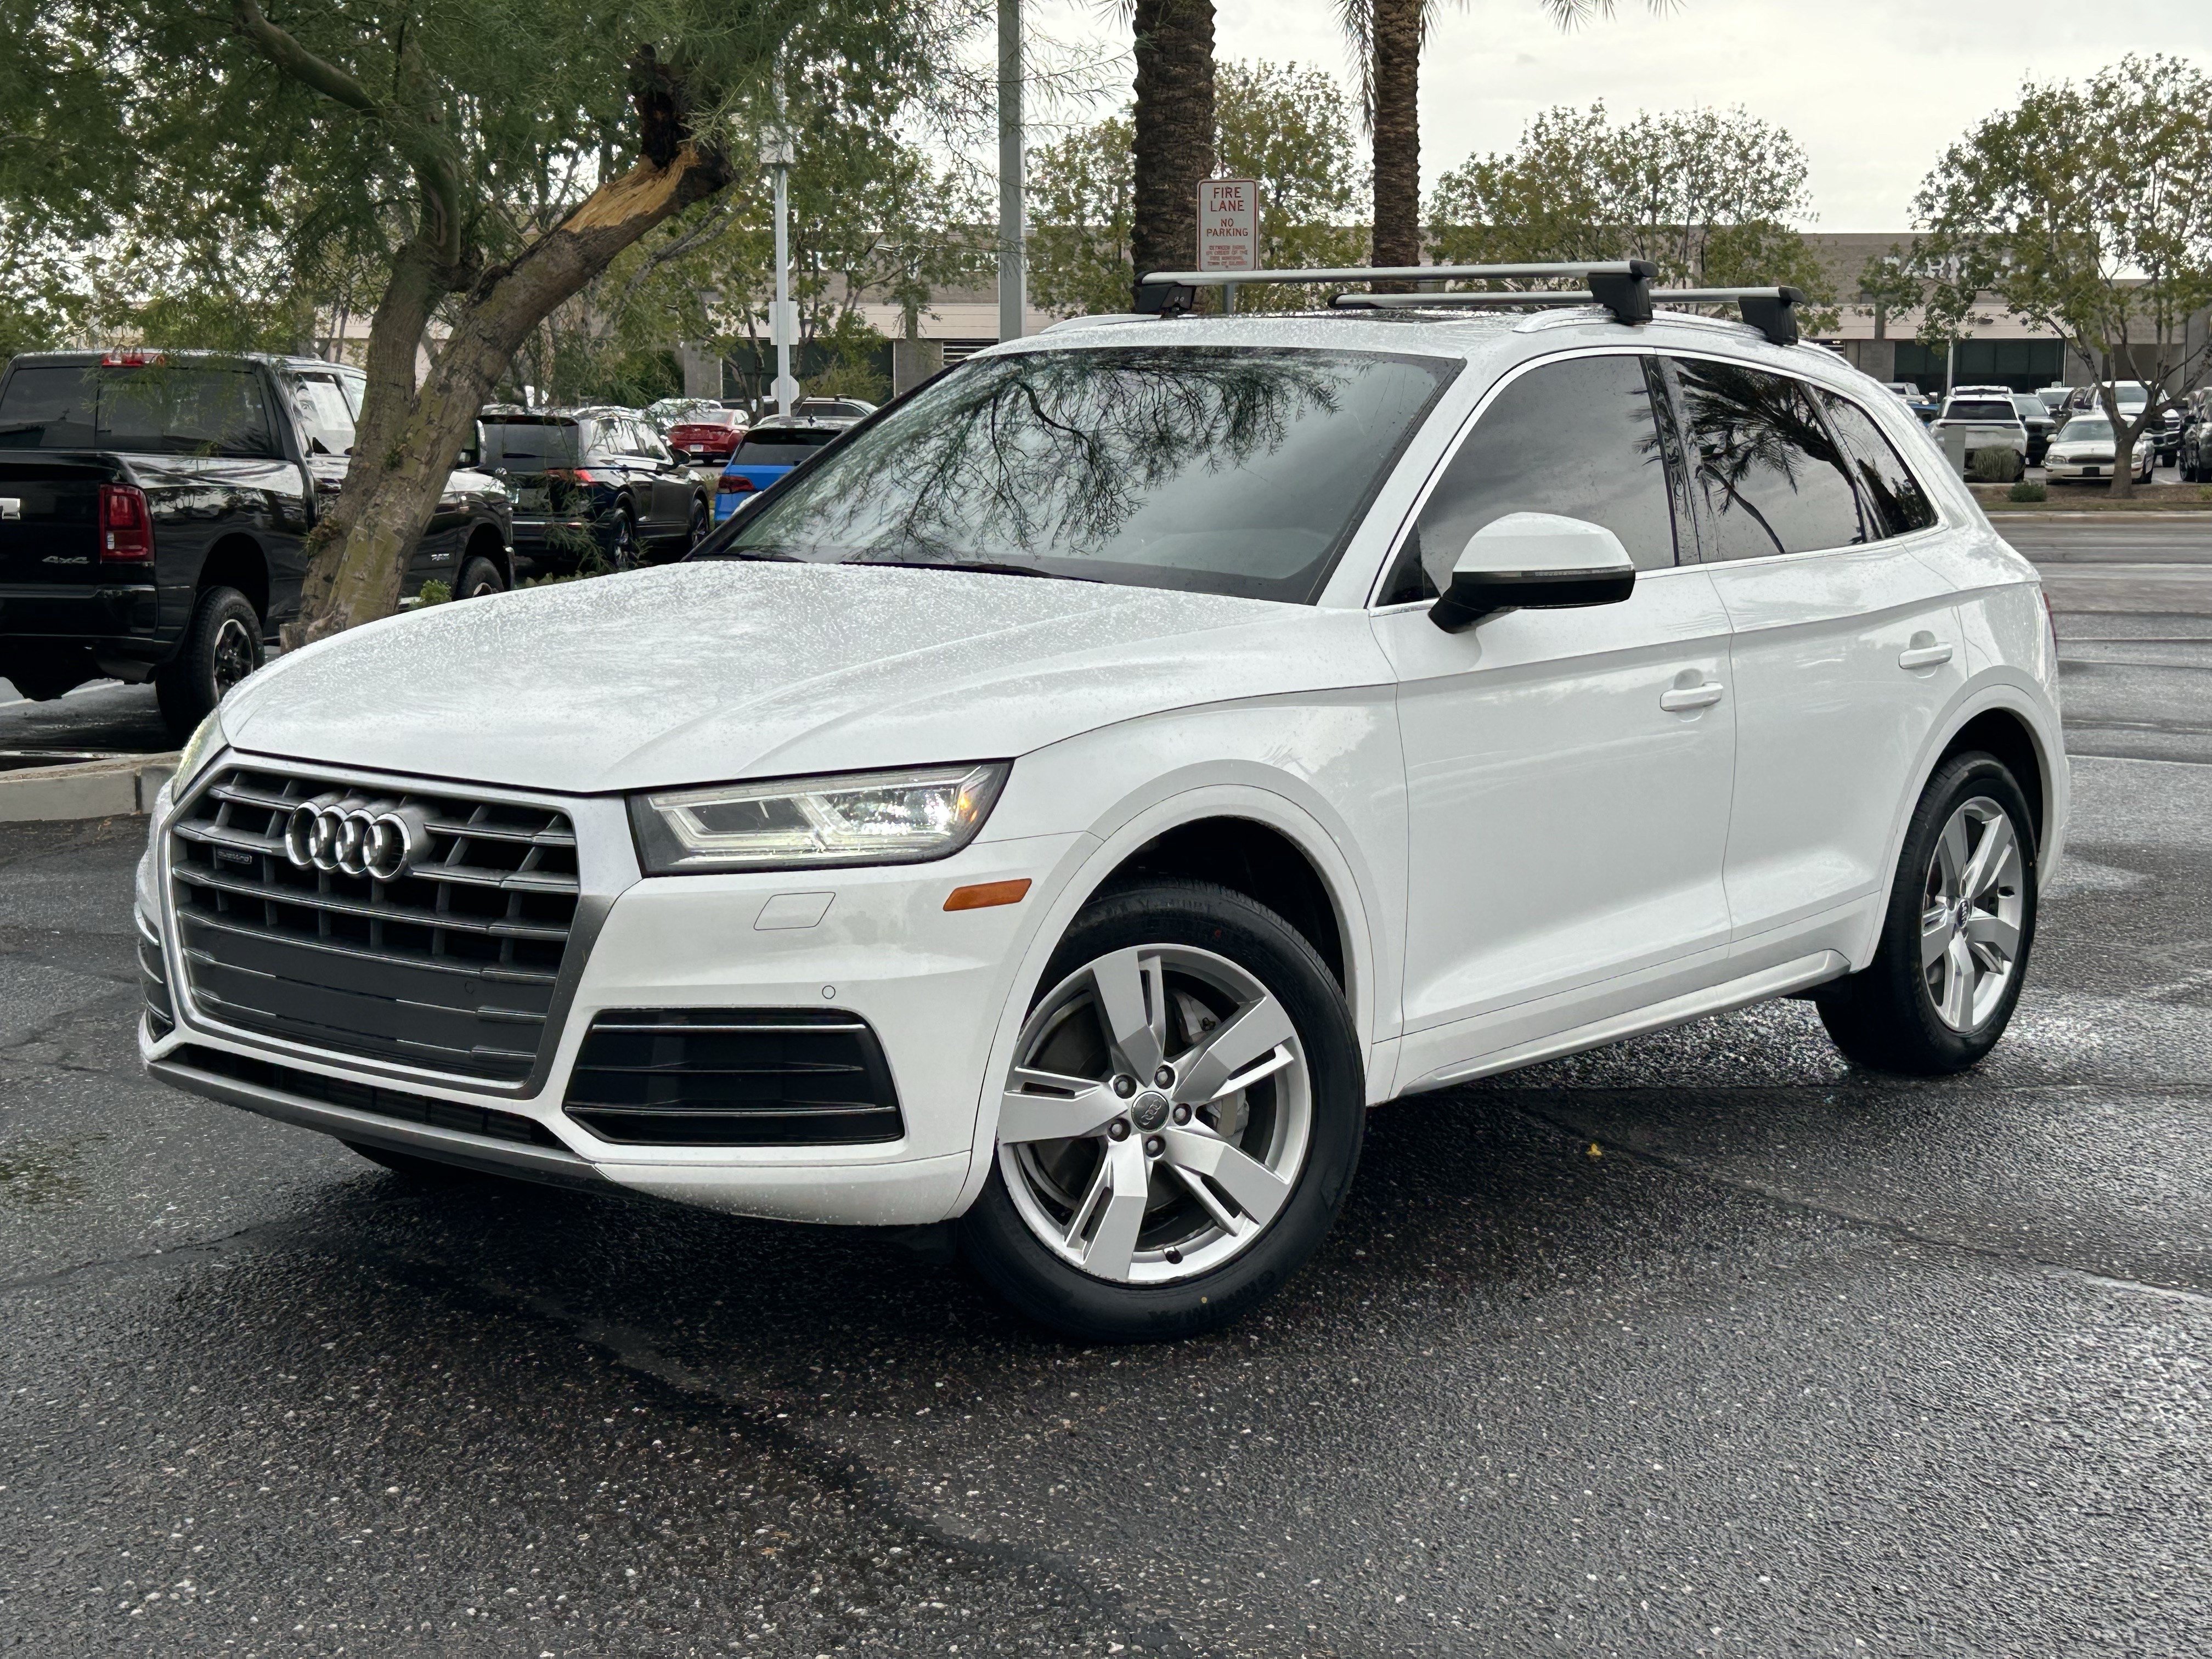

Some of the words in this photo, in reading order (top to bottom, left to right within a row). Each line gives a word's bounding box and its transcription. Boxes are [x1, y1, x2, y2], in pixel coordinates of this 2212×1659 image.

[1214, 187, 1242, 199] FIRE
[1210, 200, 1245, 212] LANE
[1220, 218, 1234, 227] NO
[1206, 228, 1249, 237] PARKING
